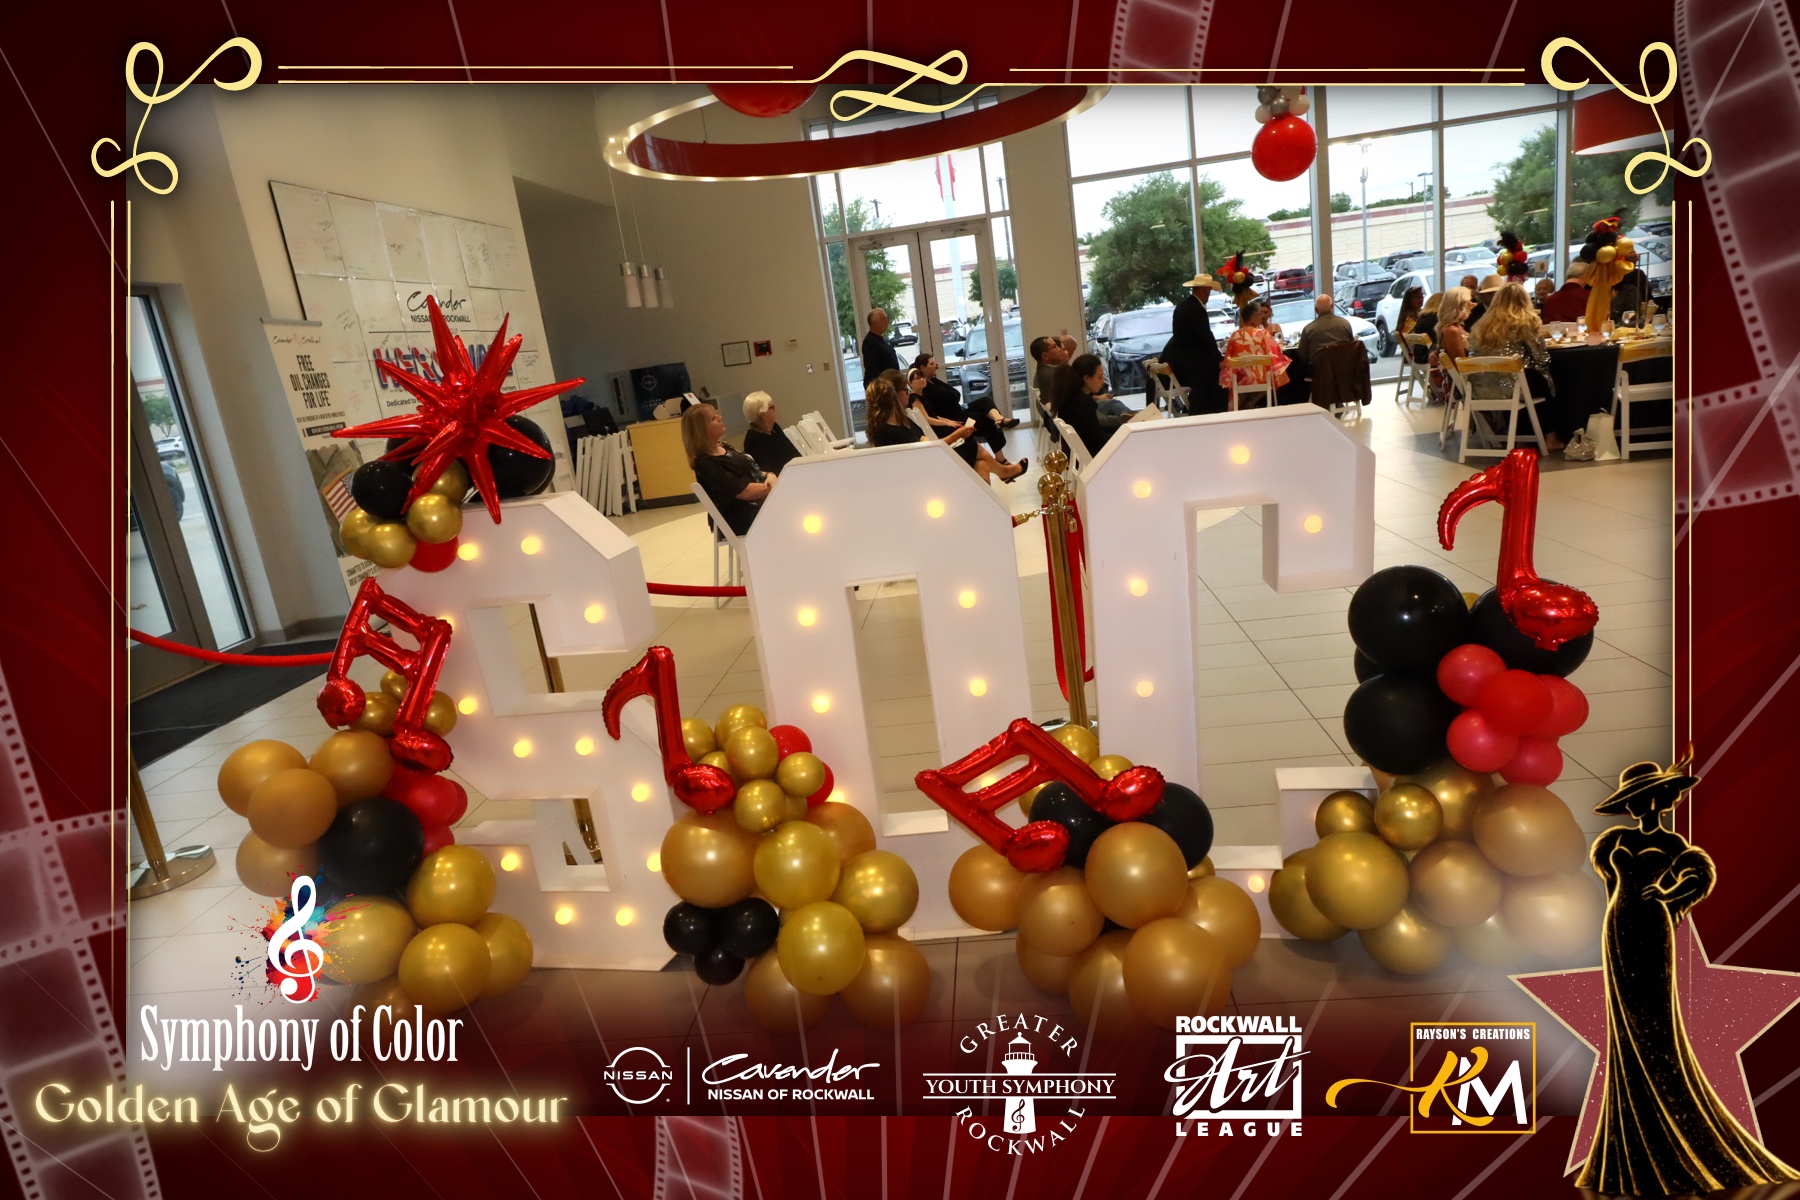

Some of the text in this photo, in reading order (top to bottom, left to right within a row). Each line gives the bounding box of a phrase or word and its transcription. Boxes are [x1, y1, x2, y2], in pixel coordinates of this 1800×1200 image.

[296, 355, 315, 371] FREE
[290, 372, 331, 391] OIL CHANGES
[302, 392, 317, 409] FOR
[386, 398, 411, 408] Dedicated
